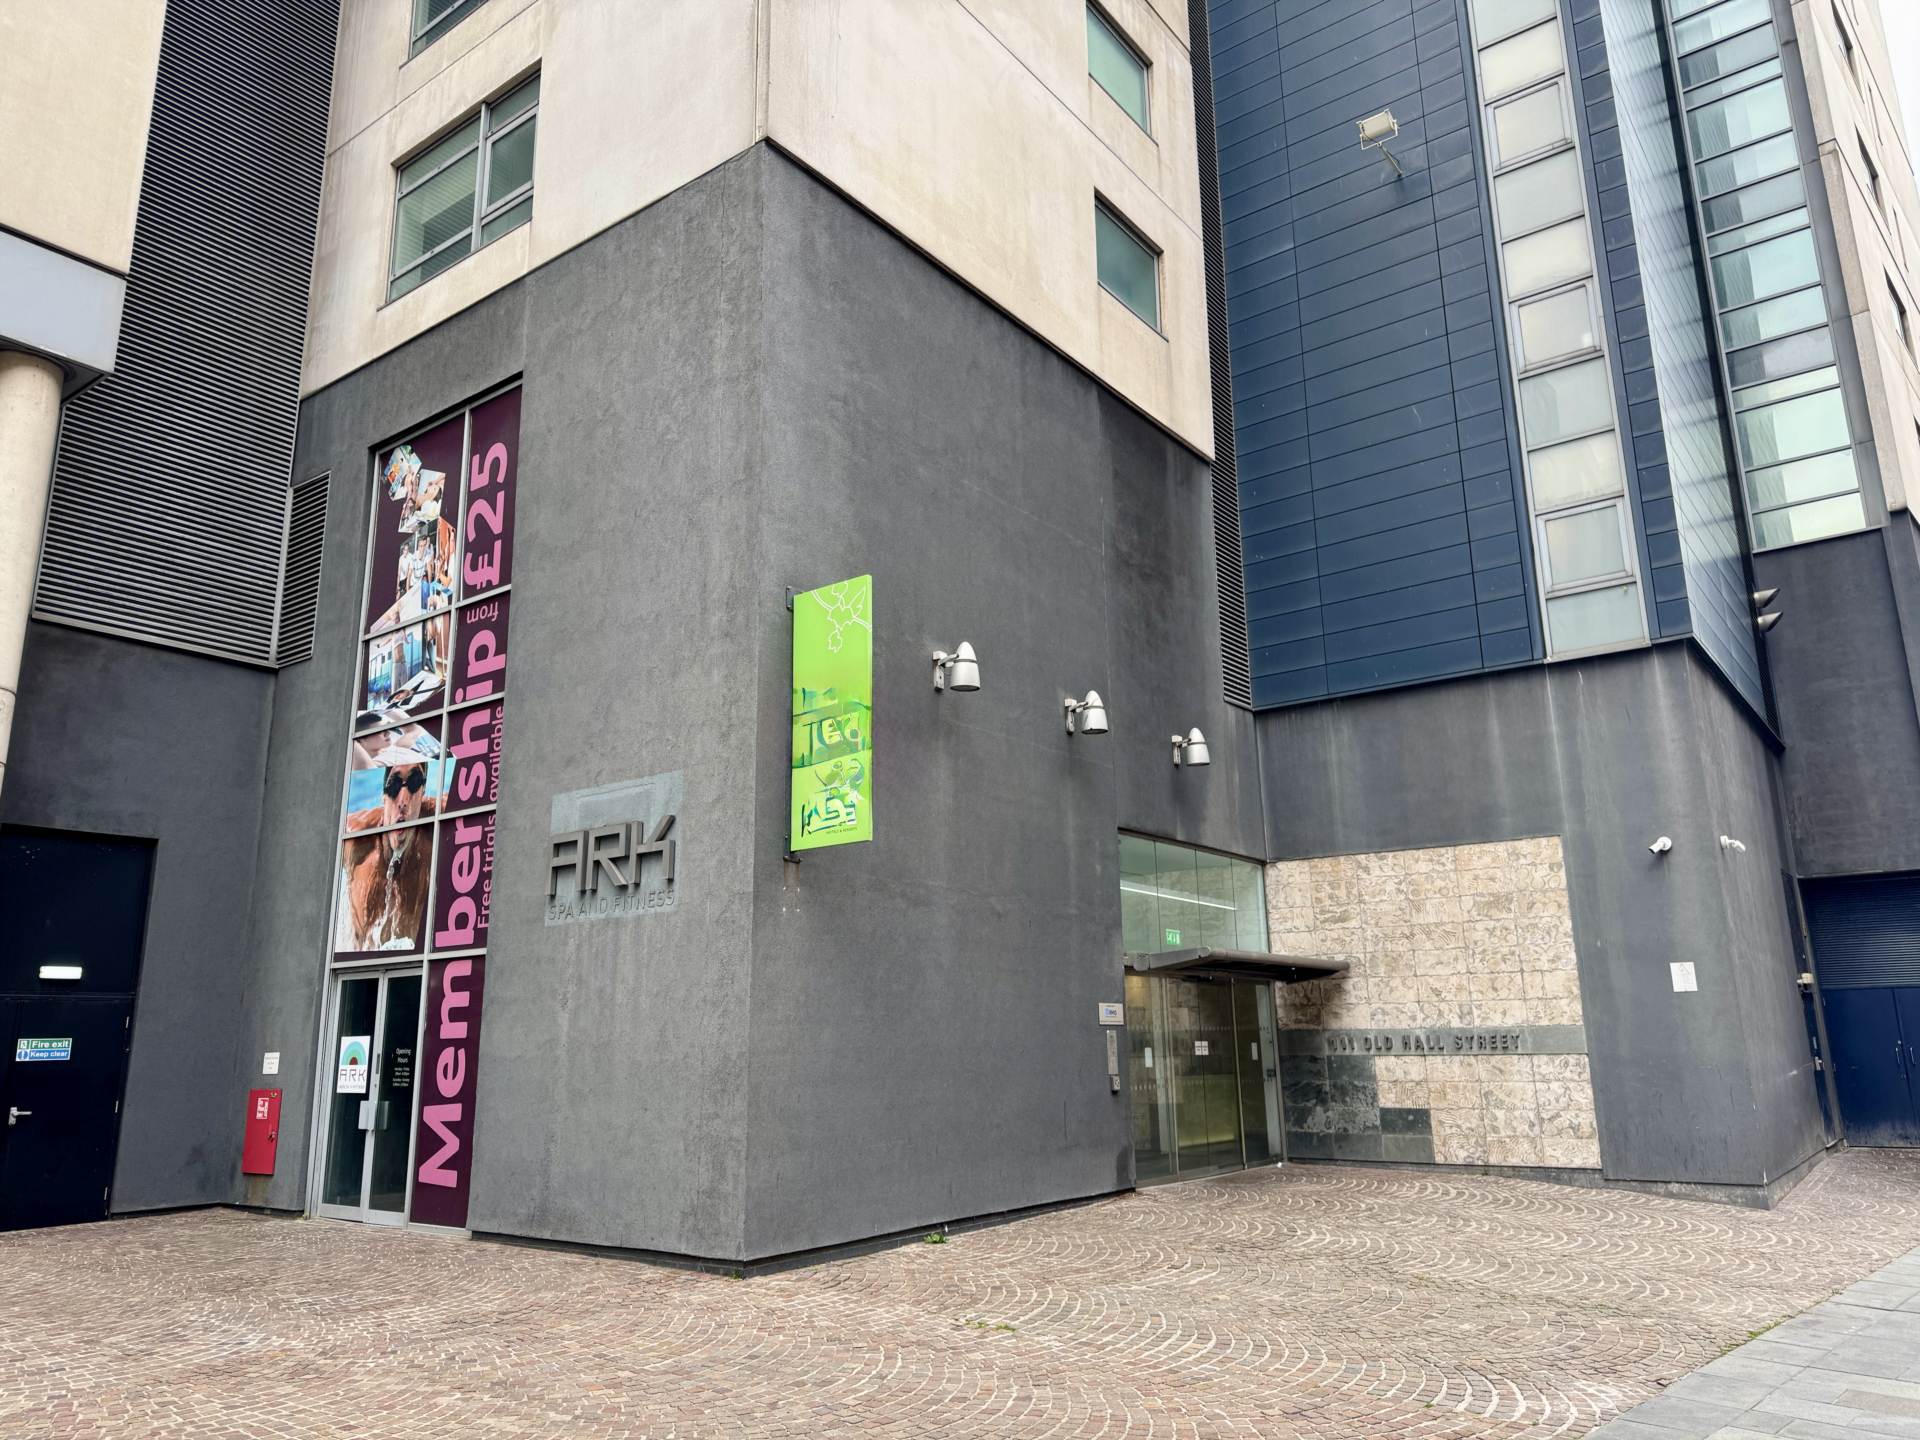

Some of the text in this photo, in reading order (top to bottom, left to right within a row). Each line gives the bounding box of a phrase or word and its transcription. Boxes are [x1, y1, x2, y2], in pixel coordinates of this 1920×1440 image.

[418, 442, 508, 1188] Membership from £25
[477, 705, 504, 929] Free trials available
[545, 815, 676, 898] ARK
[549, 903, 574, 921] SPA
[612, 889, 675, 914] FITNESS
[31, 1050, 68, 1059] Keep clear
[32, 1040, 69, 1049] Fire exit
[1364, 1035, 1394, 1051] OLD
[1402, 1035, 1445, 1051] HALL
[1455, 1033, 1520, 1050] STREET
[339, 1068, 367, 1082] ARK
